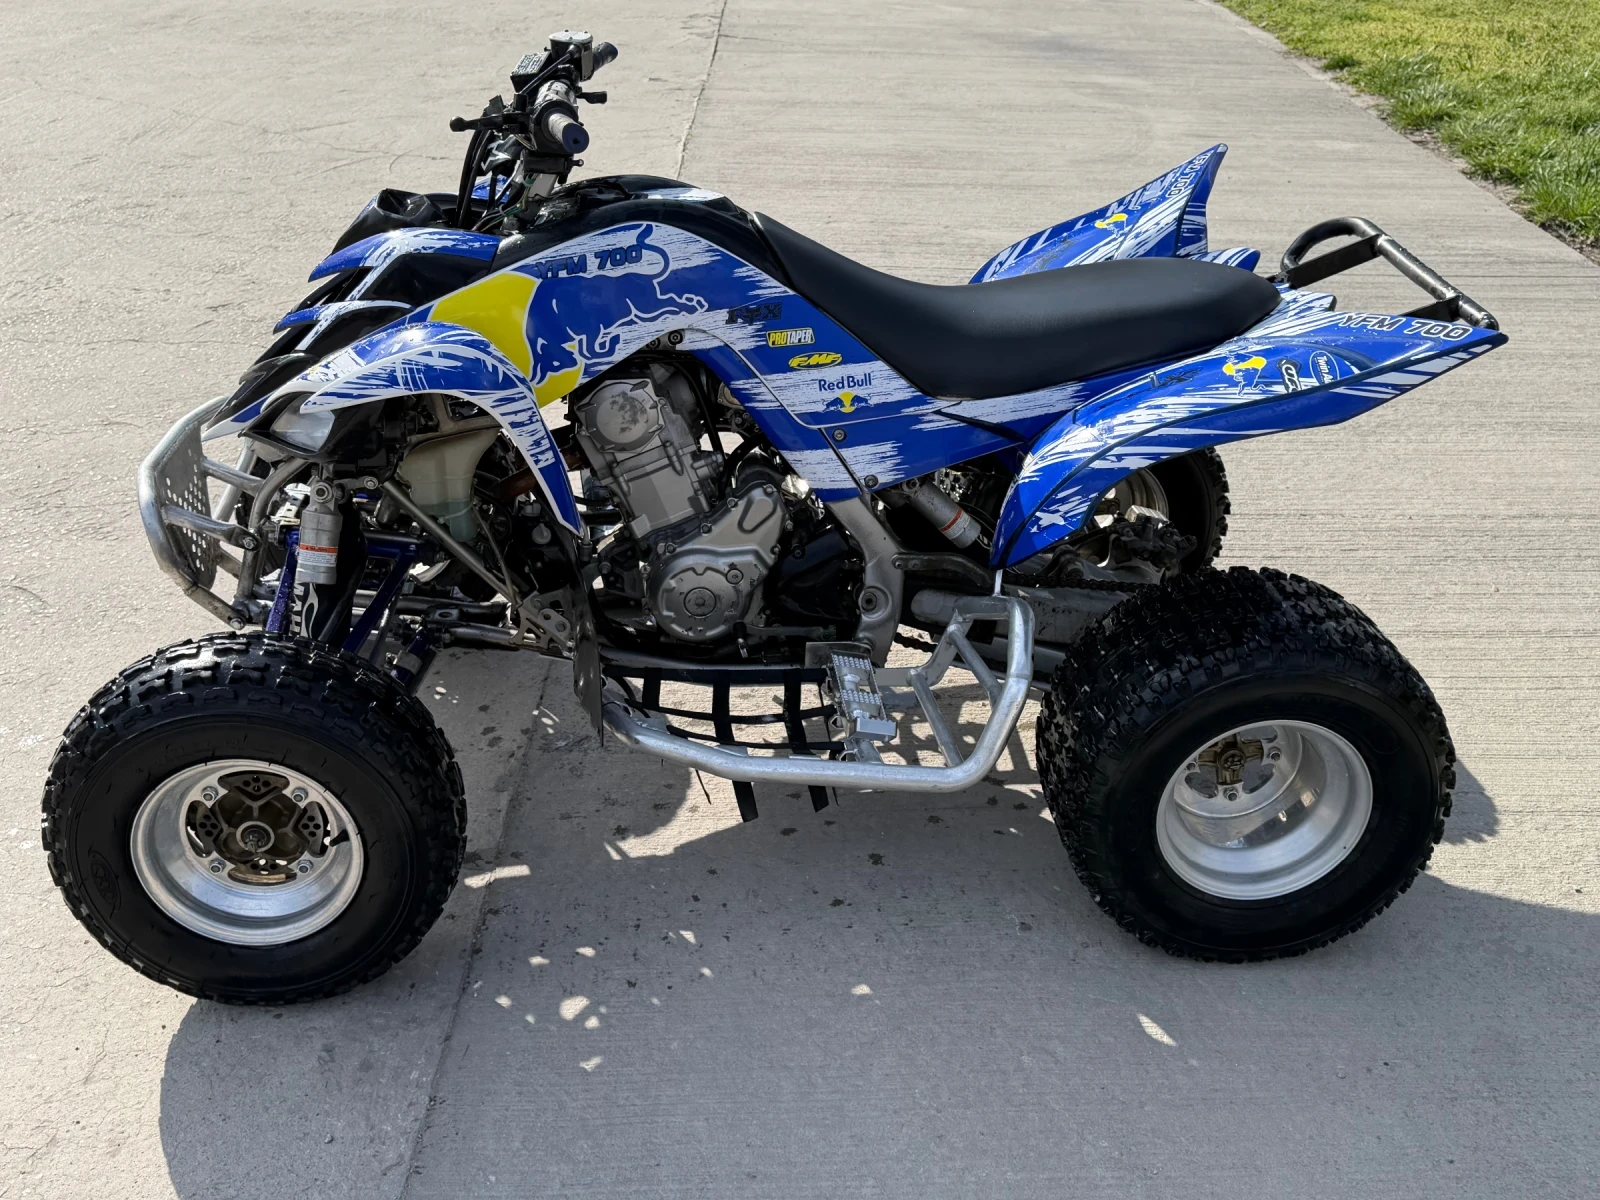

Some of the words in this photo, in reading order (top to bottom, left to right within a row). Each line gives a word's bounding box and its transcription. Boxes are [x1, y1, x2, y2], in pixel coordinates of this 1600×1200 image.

[535, 254, 588, 279] YFM
[594, 244, 643, 270] 700
[1338, 312, 1406, 331] YFM
[1403, 320, 1473, 341] 700
[789, 352, 842, 369] FMF
[1316, 355, 1330, 373] Twin
[818, 375, 845, 392] Red
[846, 372, 872, 389] Bull
